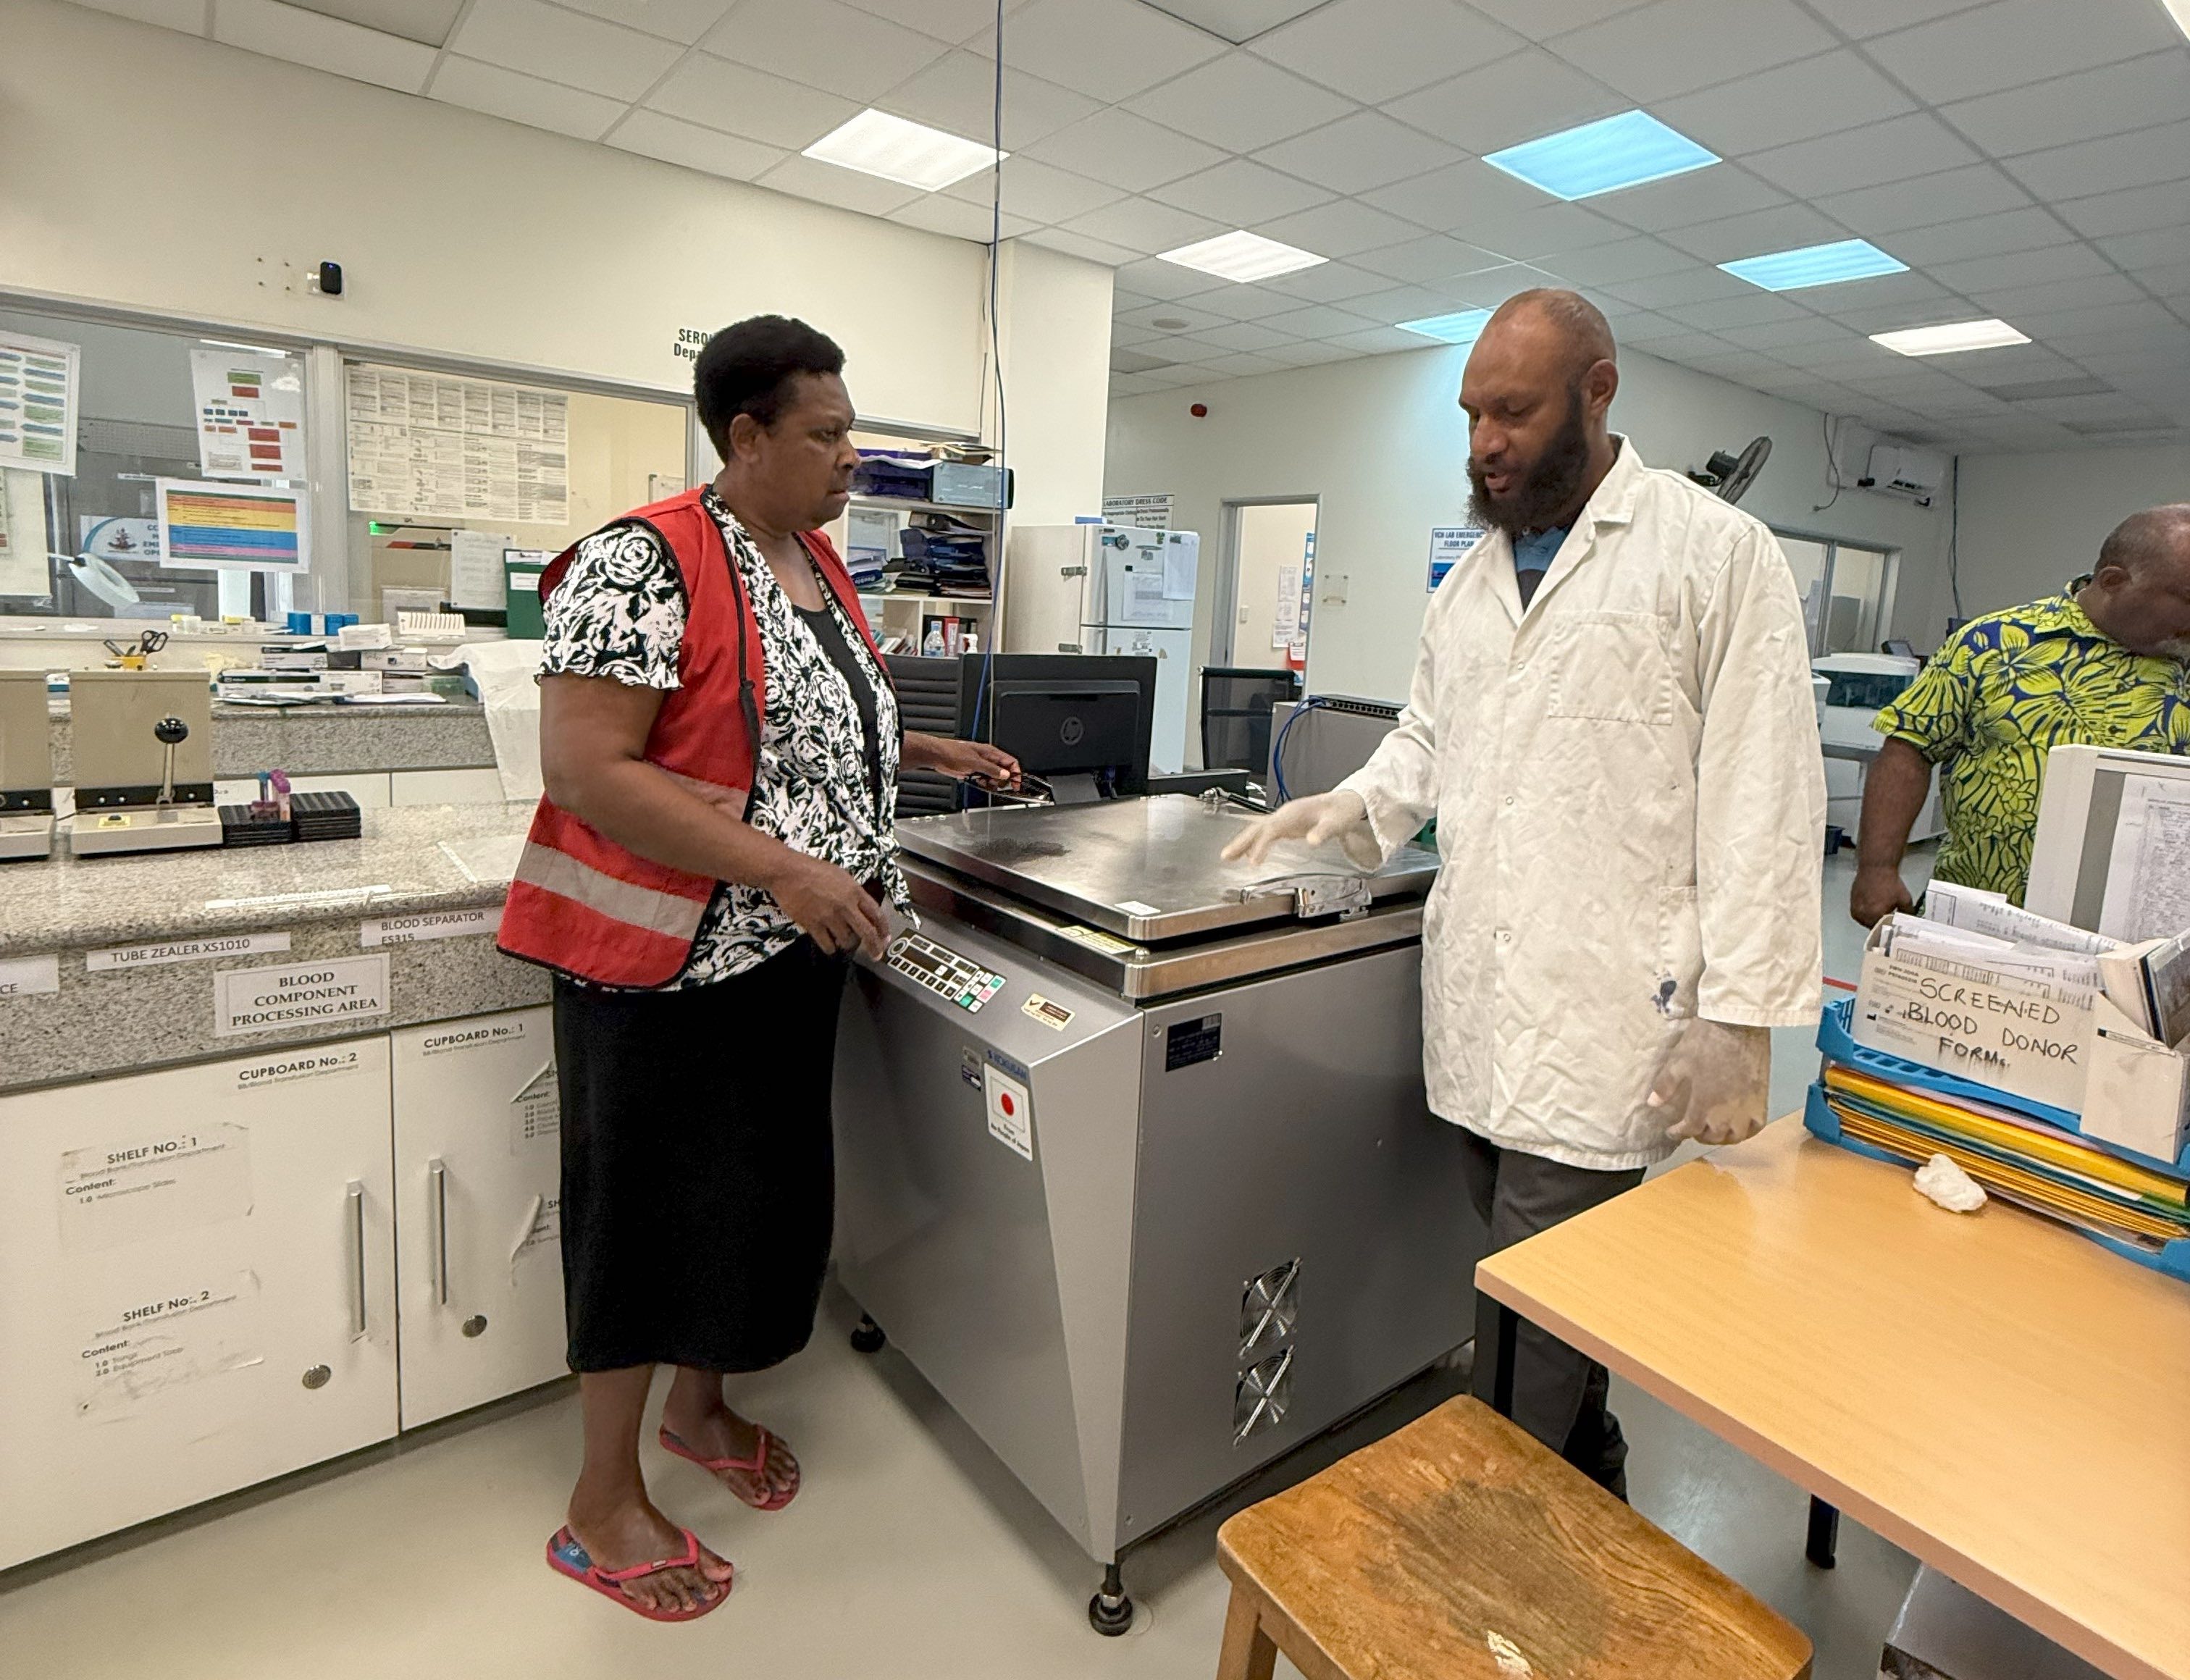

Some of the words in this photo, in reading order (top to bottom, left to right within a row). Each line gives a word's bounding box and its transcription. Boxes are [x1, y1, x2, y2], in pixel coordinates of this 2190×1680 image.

[382, 918, 420, 931] BLOOD
[422, 912, 484, 927] SEPARATOR
[112, 949, 148, 963] TUBE
[151, 944, 199, 958] ZEALER
[204, 938, 251, 953] XS1010
[279, 972, 335, 988] BLOOD
[254, 985, 358, 1007] COMPONENT
[1920, 978, 2060, 1024] SCREENED
[232, 1004, 334, 1026] PROCESSING
[337, 998, 378, 1012] AREA
[424, 1030, 489, 1049] CUPBOARD
[518, 1023, 523, 1032] 1
[1908, 1001, 1978, 1035] BLOOD
[2002, 1027, 2078, 1065] DONOR
[239, 1059, 315, 1080] CUPBOARD
[349, 1052, 357, 1062] 2
[107, 1147, 149, 1164] SHELF
[122, 1303, 164, 1322] SHELF
[201, 1291, 209, 1301] 2
